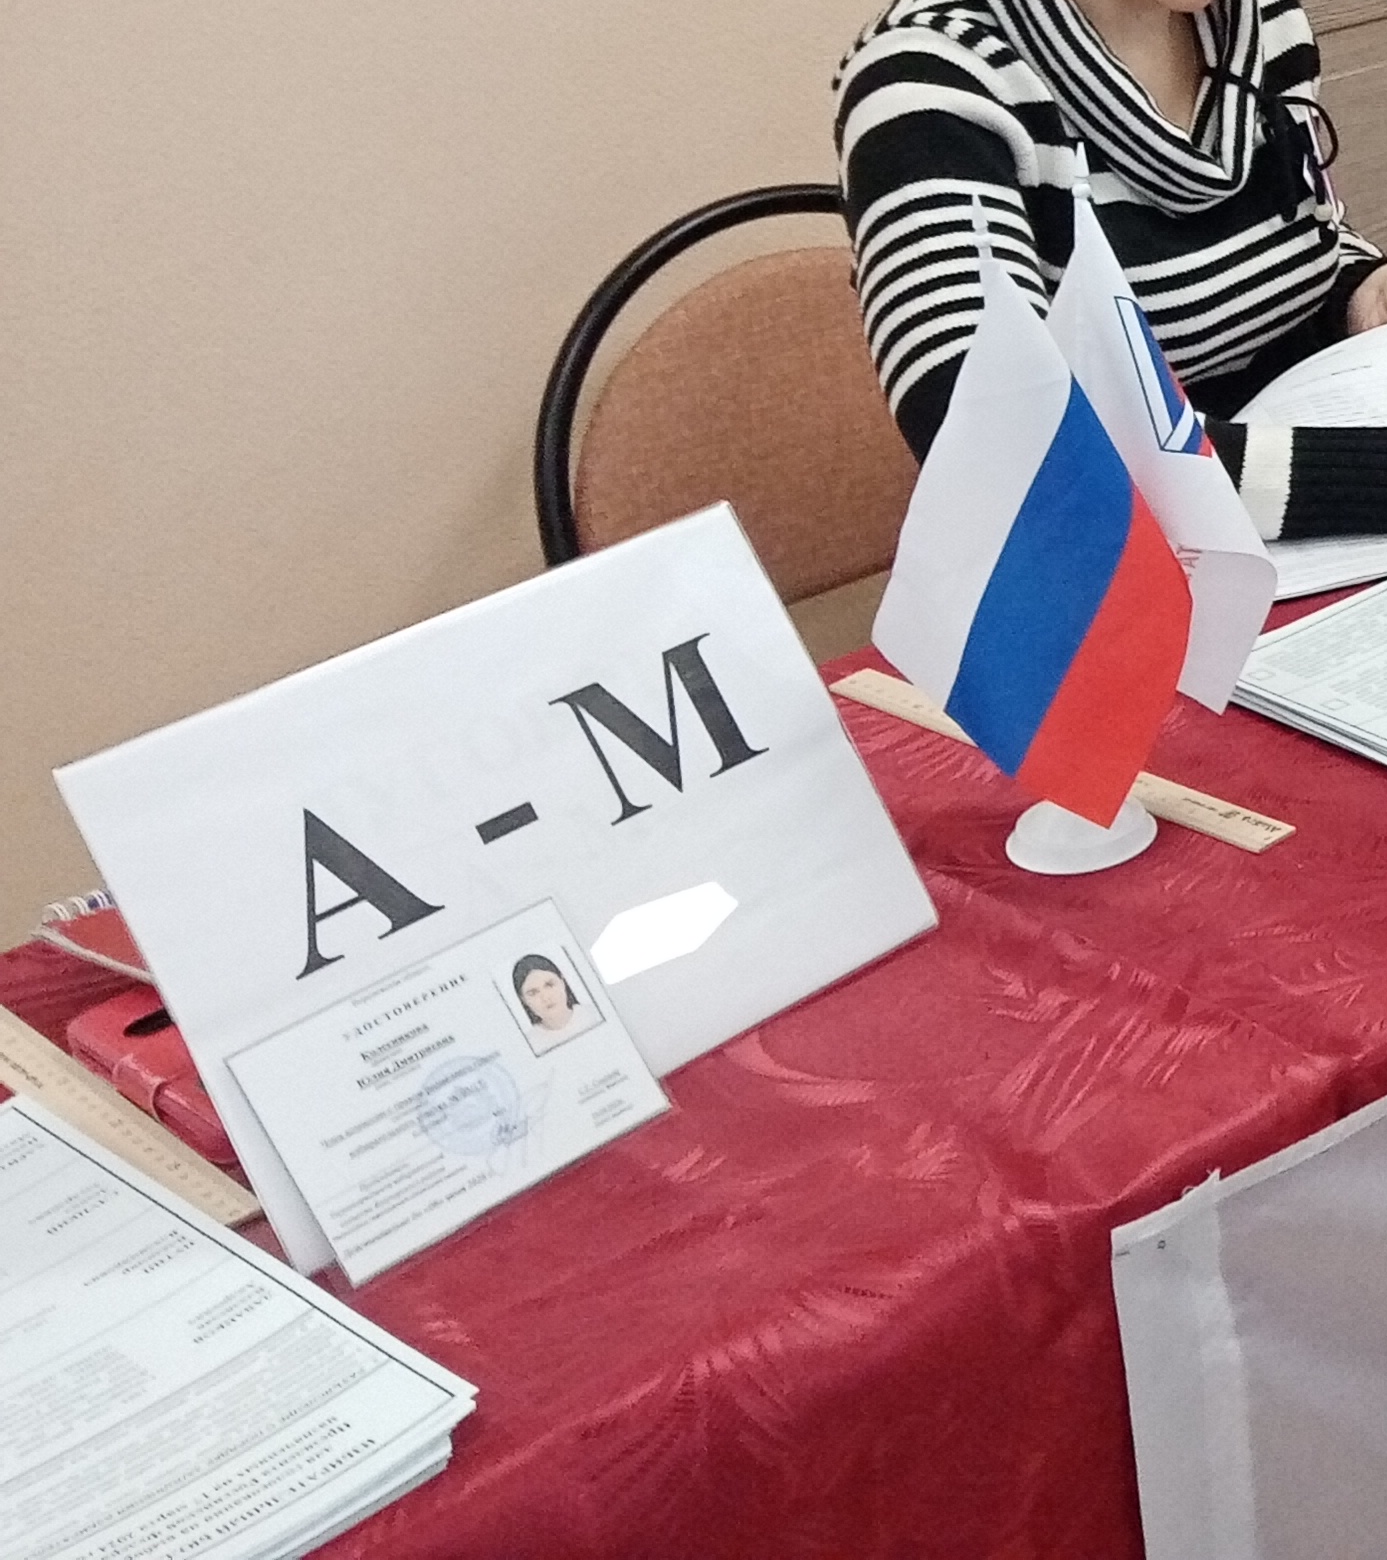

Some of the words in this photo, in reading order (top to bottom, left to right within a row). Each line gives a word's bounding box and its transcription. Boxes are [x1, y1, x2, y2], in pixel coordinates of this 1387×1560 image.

[297, 808, 444, 980] А
[548, 633, 770, 826] М
[342, 972, 468, 1042] УДОСТОВЕРЕНИЕ
